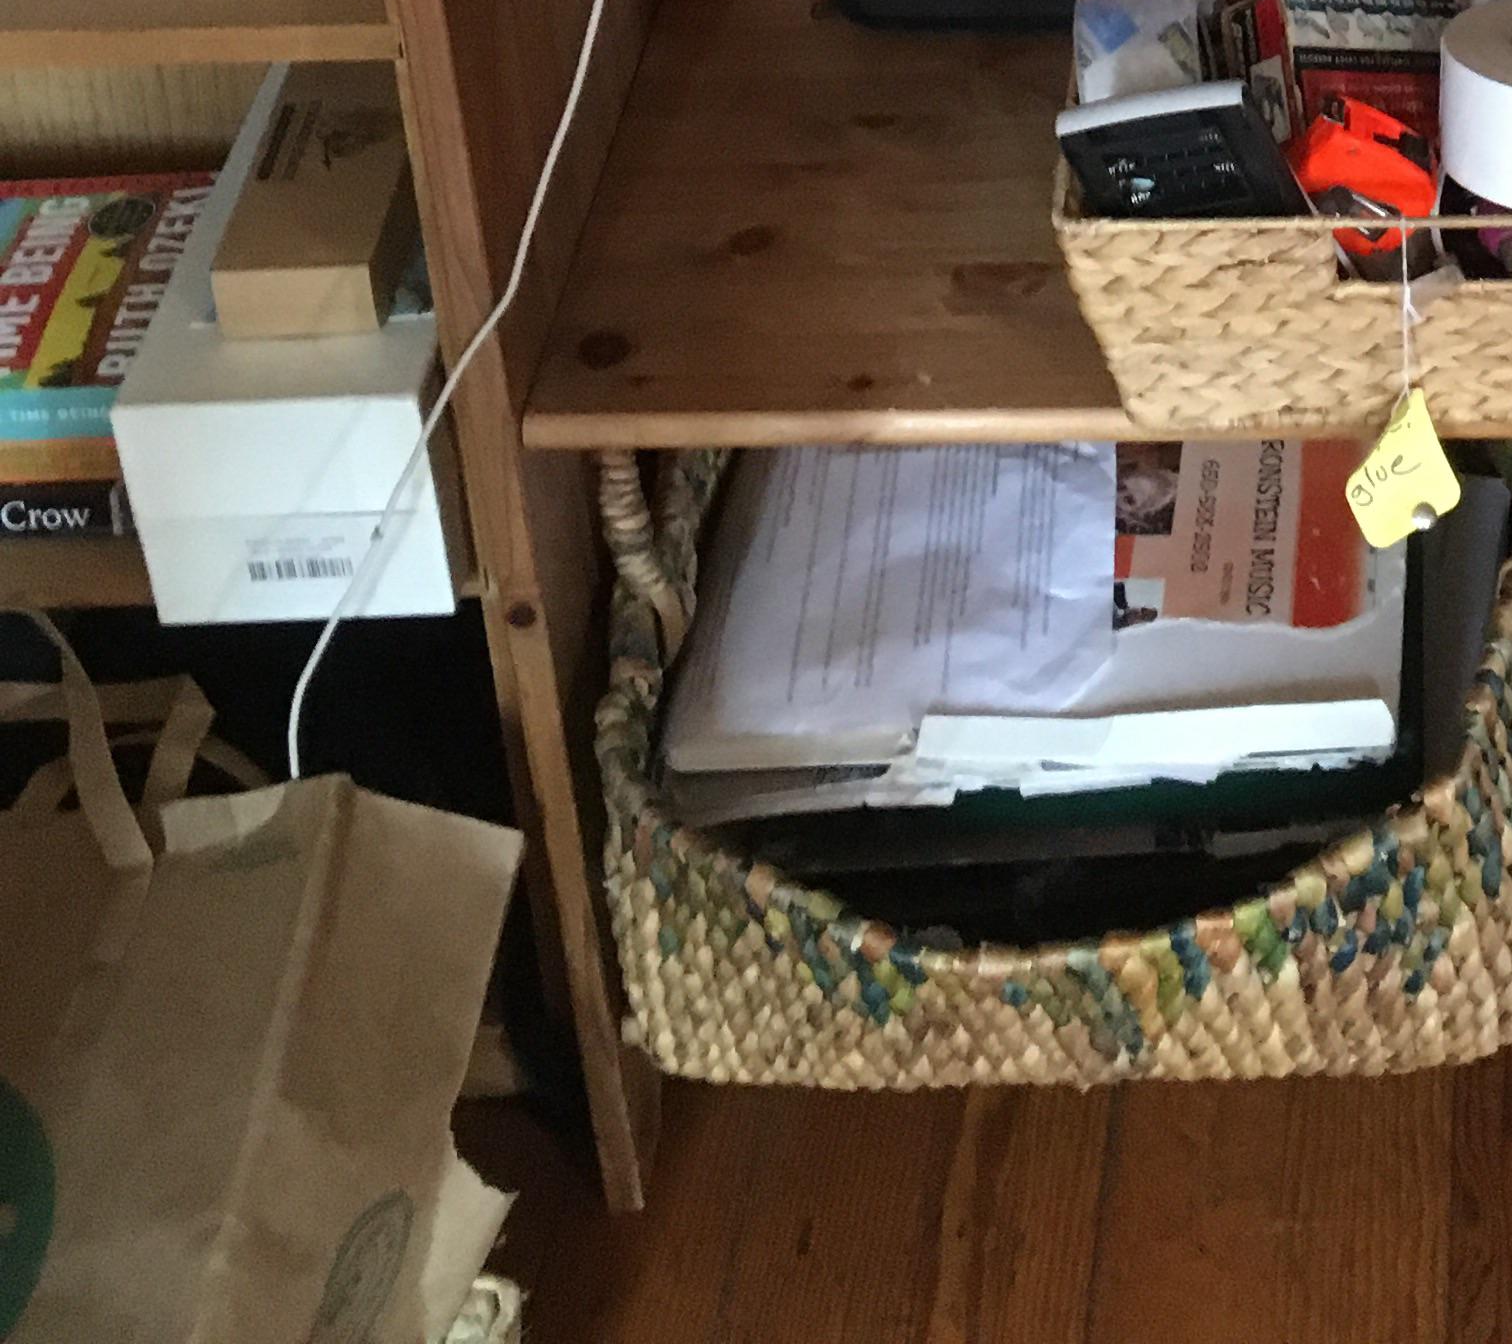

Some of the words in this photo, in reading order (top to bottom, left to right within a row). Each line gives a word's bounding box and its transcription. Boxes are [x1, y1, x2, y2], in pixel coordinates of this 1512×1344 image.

[1253, 439, 1286, 542] RONSTEIN
[1351, 453, 1421, 507] glue
[1, 500, 91, 532] Crow
[1244, 547, 1275, 616] MUSIC
